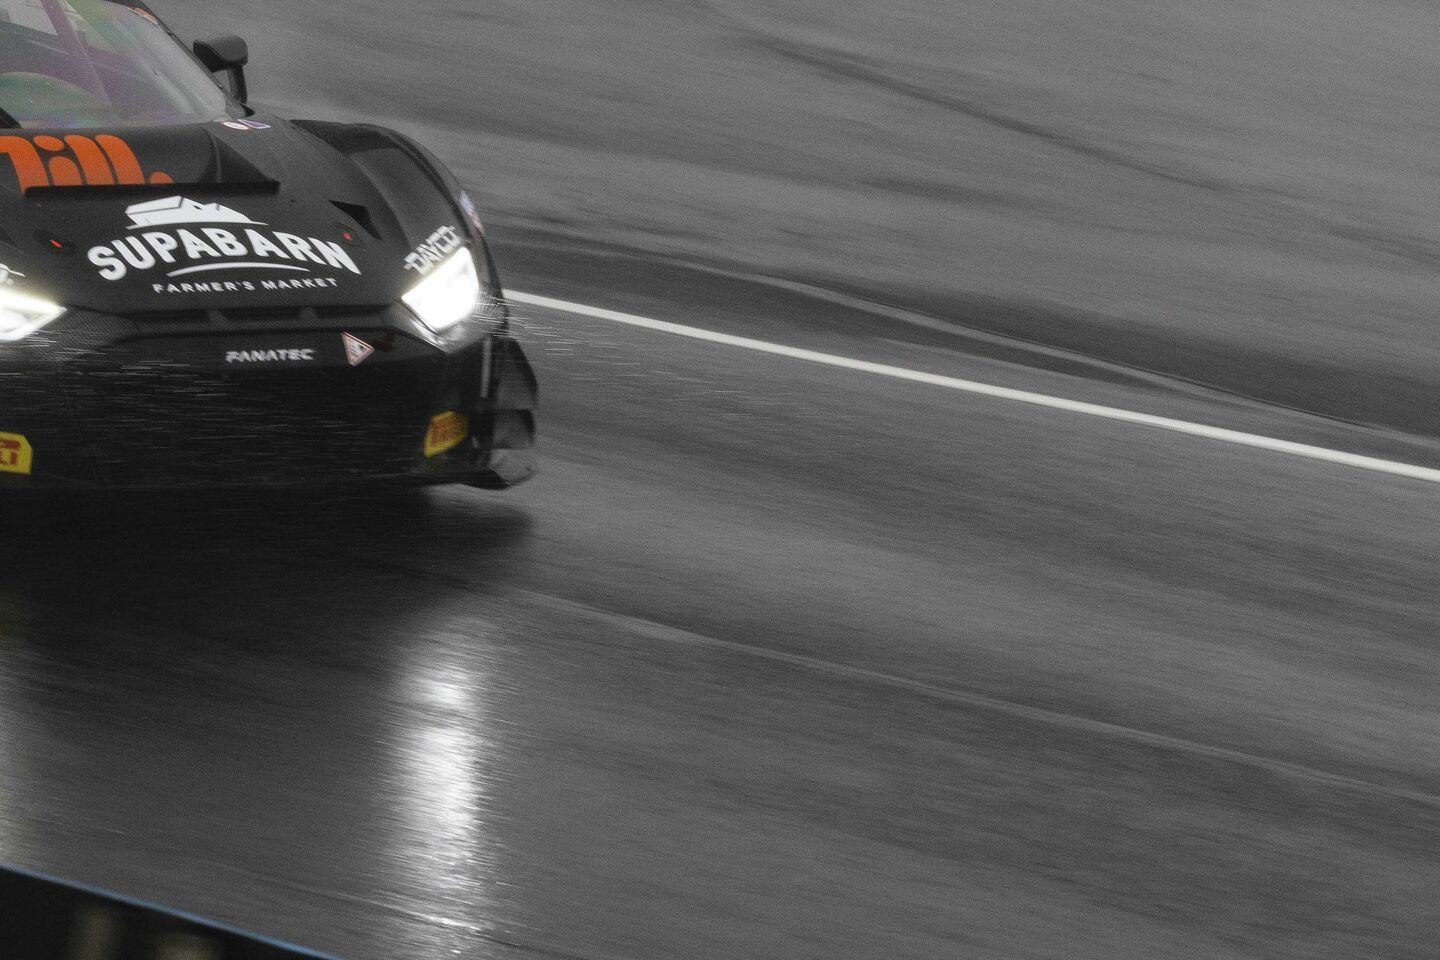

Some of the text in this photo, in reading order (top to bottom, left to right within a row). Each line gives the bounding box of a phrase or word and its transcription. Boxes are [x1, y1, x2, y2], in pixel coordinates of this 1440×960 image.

[87, 227, 362, 282] SUPABARN
[152, 277, 338, 294] FARMER'S MARKET
[225, 348, 316, 363] FANATEC
